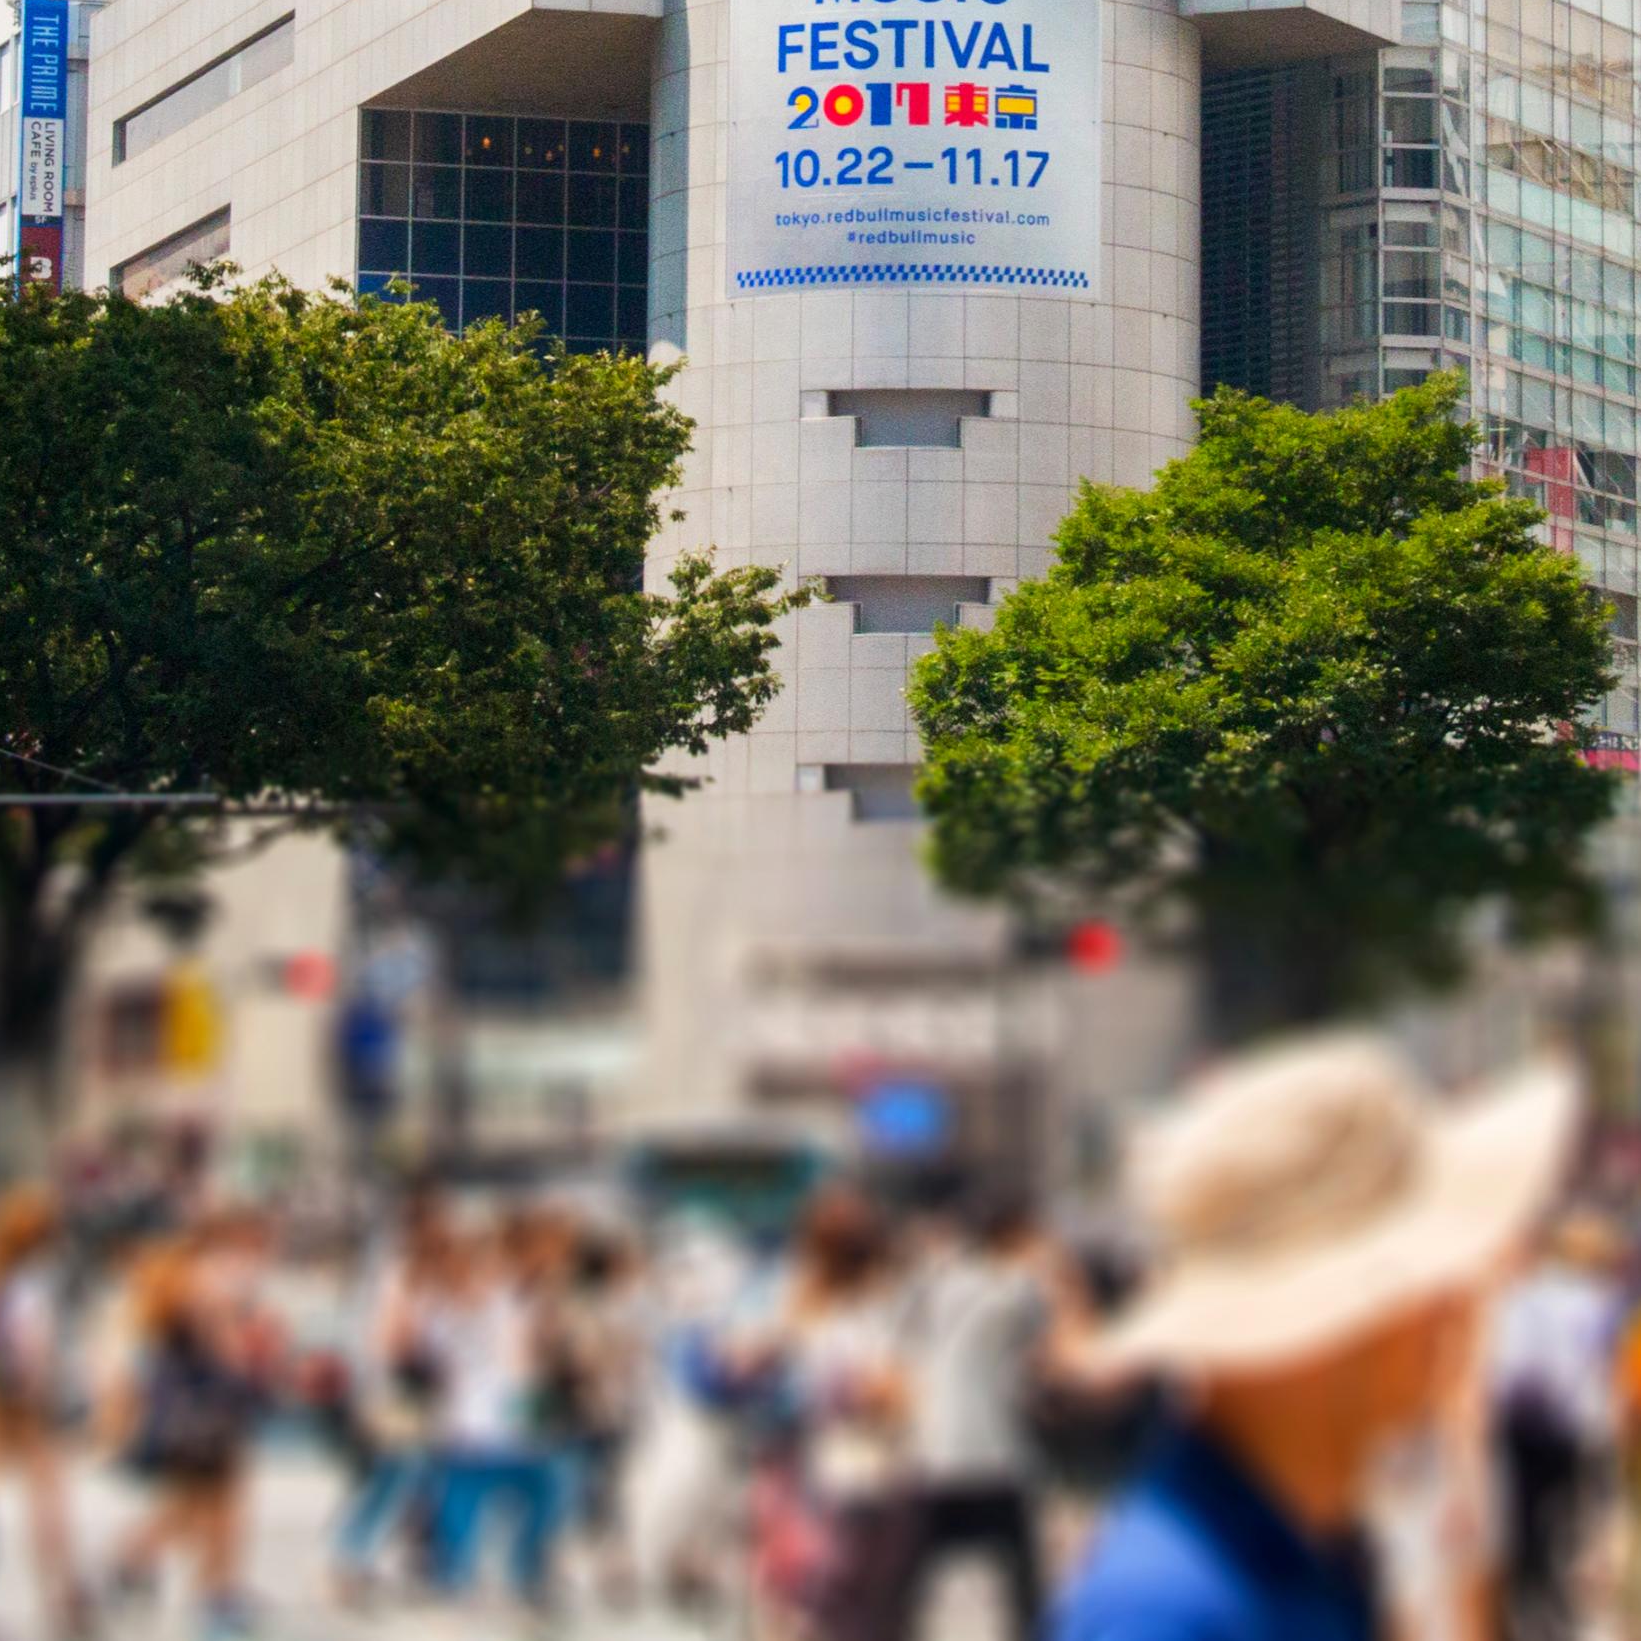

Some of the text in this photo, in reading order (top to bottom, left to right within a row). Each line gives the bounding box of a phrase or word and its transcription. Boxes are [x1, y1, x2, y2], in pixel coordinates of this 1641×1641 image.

[30, 13, 60, 112] THE PRIME
[777, 19, 1050, 74] FESTIVAL
[788, 82, 1038, 131] 2017 東京
[30, 121, 42, 157] CAFE
[30, 162, 39, 174] by
[42, 121, 57, 213] LIVING ROOM
[775, 205, 1051, 228] tokyo.redbullmusicfestival.com
[846, 229, 976, 248] #redbullmusic
